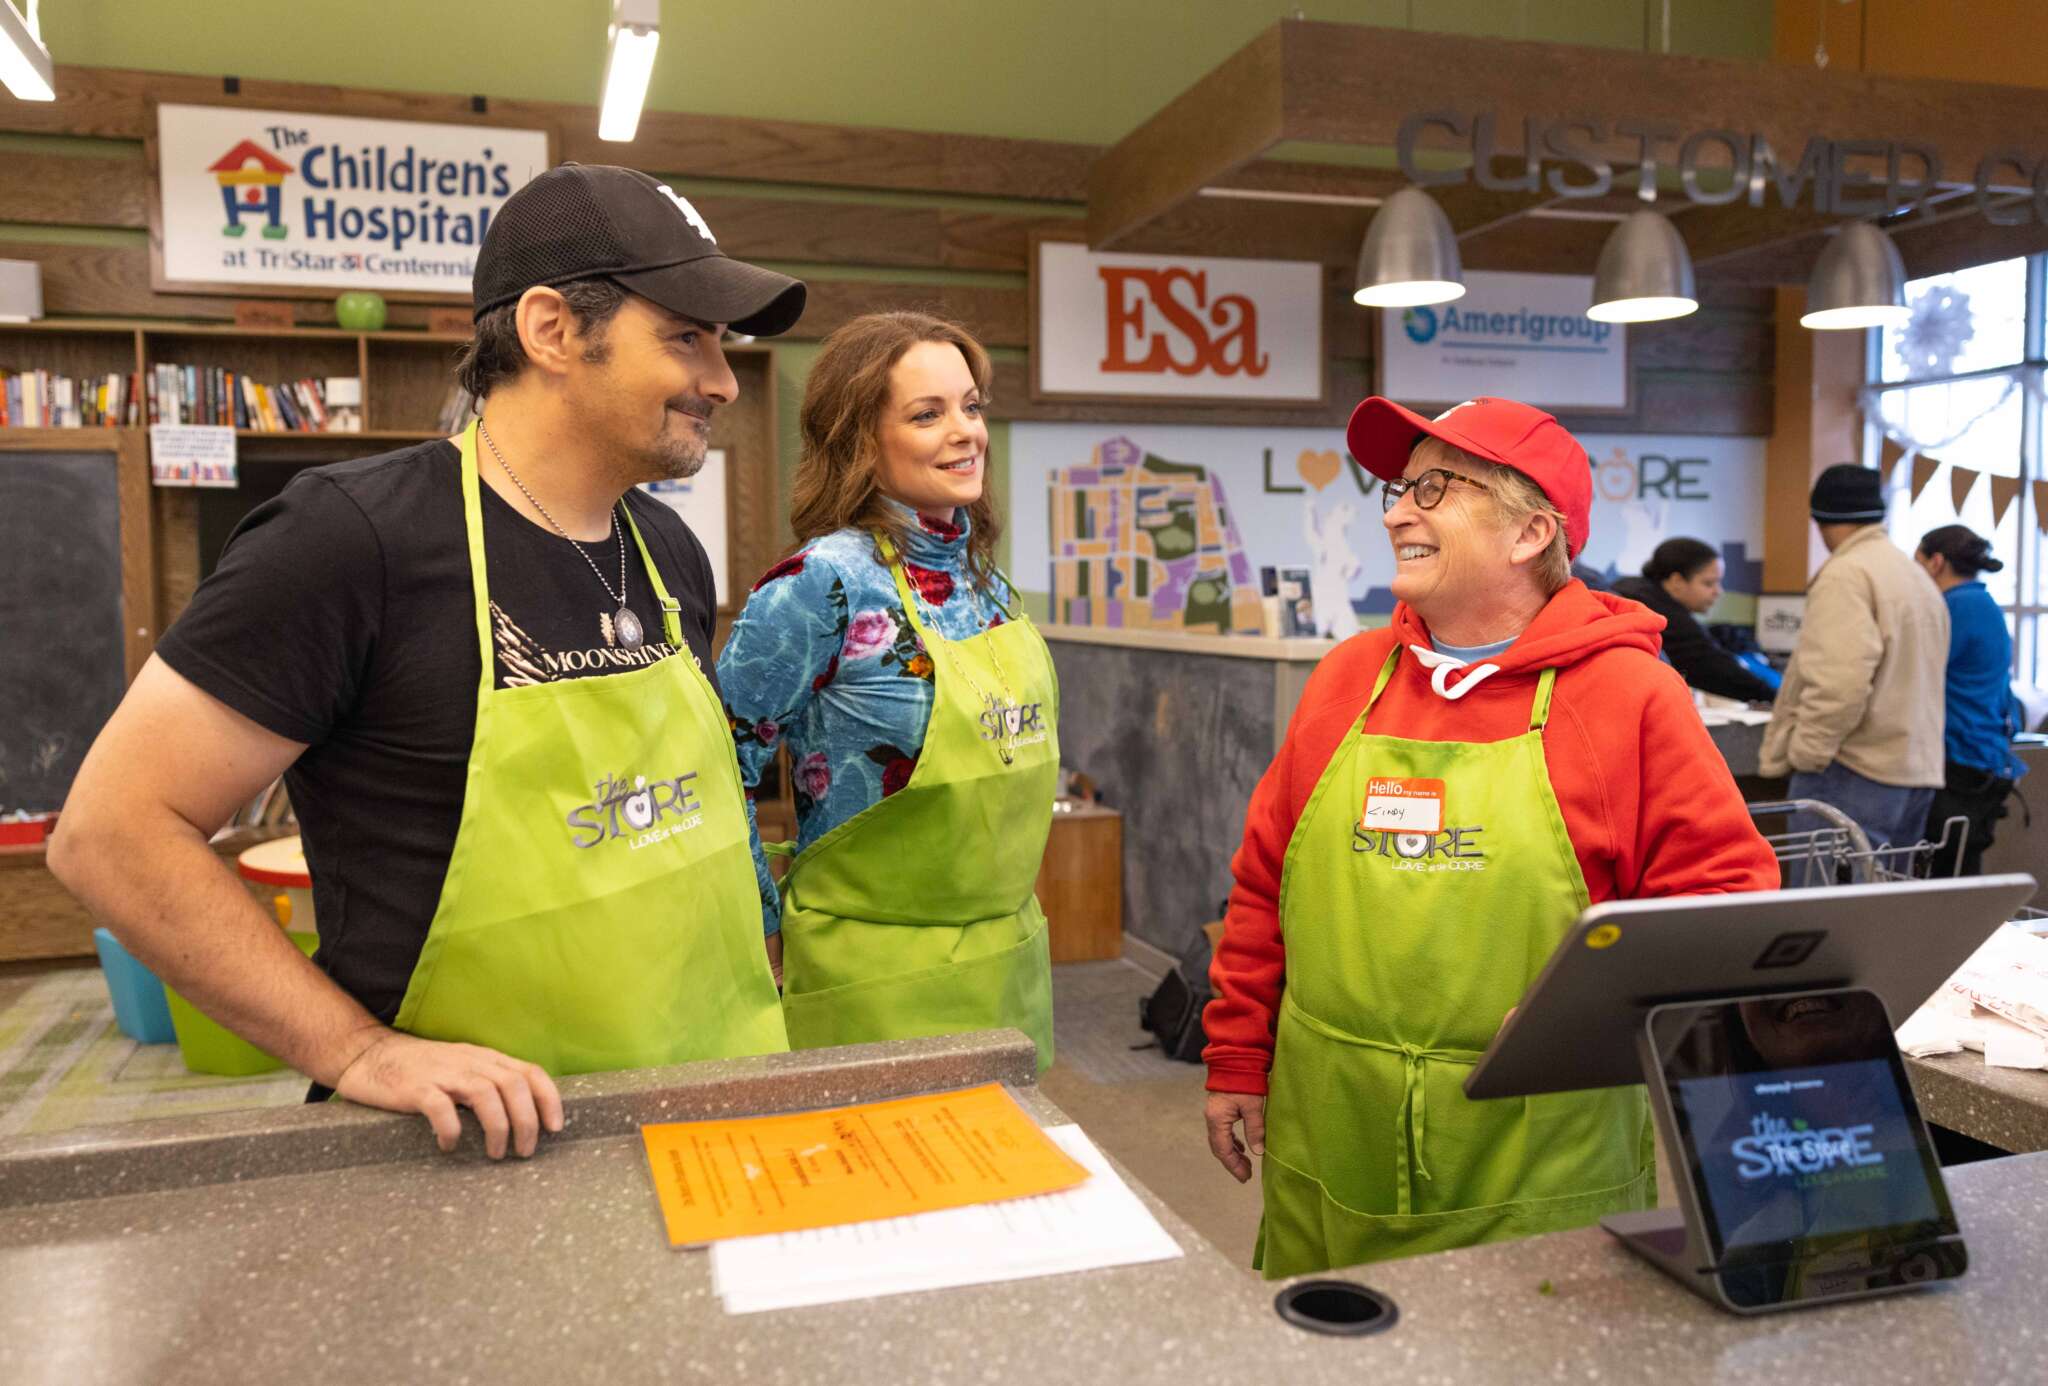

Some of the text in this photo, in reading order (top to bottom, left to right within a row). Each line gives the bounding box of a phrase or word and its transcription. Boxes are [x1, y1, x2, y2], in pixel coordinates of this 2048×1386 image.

[266, 126, 309, 149] The
[301, 144, 511, 198] Children's
[1397, 110, 1940, 224] CUSTOMER
[303, 196, 490, 252] Hospital
[223, 250, 246, 268] at
[365, 252, 475, 277] Centenni
[1441, 306, 1611, 342] Amerigroup
[979, 703, 1045, 740] STORE
[594, 772, 629, 803] the
[1369, 780, 1403, 795] Hello
[567, 771, 700, 848] STORE
[1352, 821, 1484, 860] STORE
[1391, 858, 1427, 872] LOVE
[1447, 860, 1487, 872] CORE
